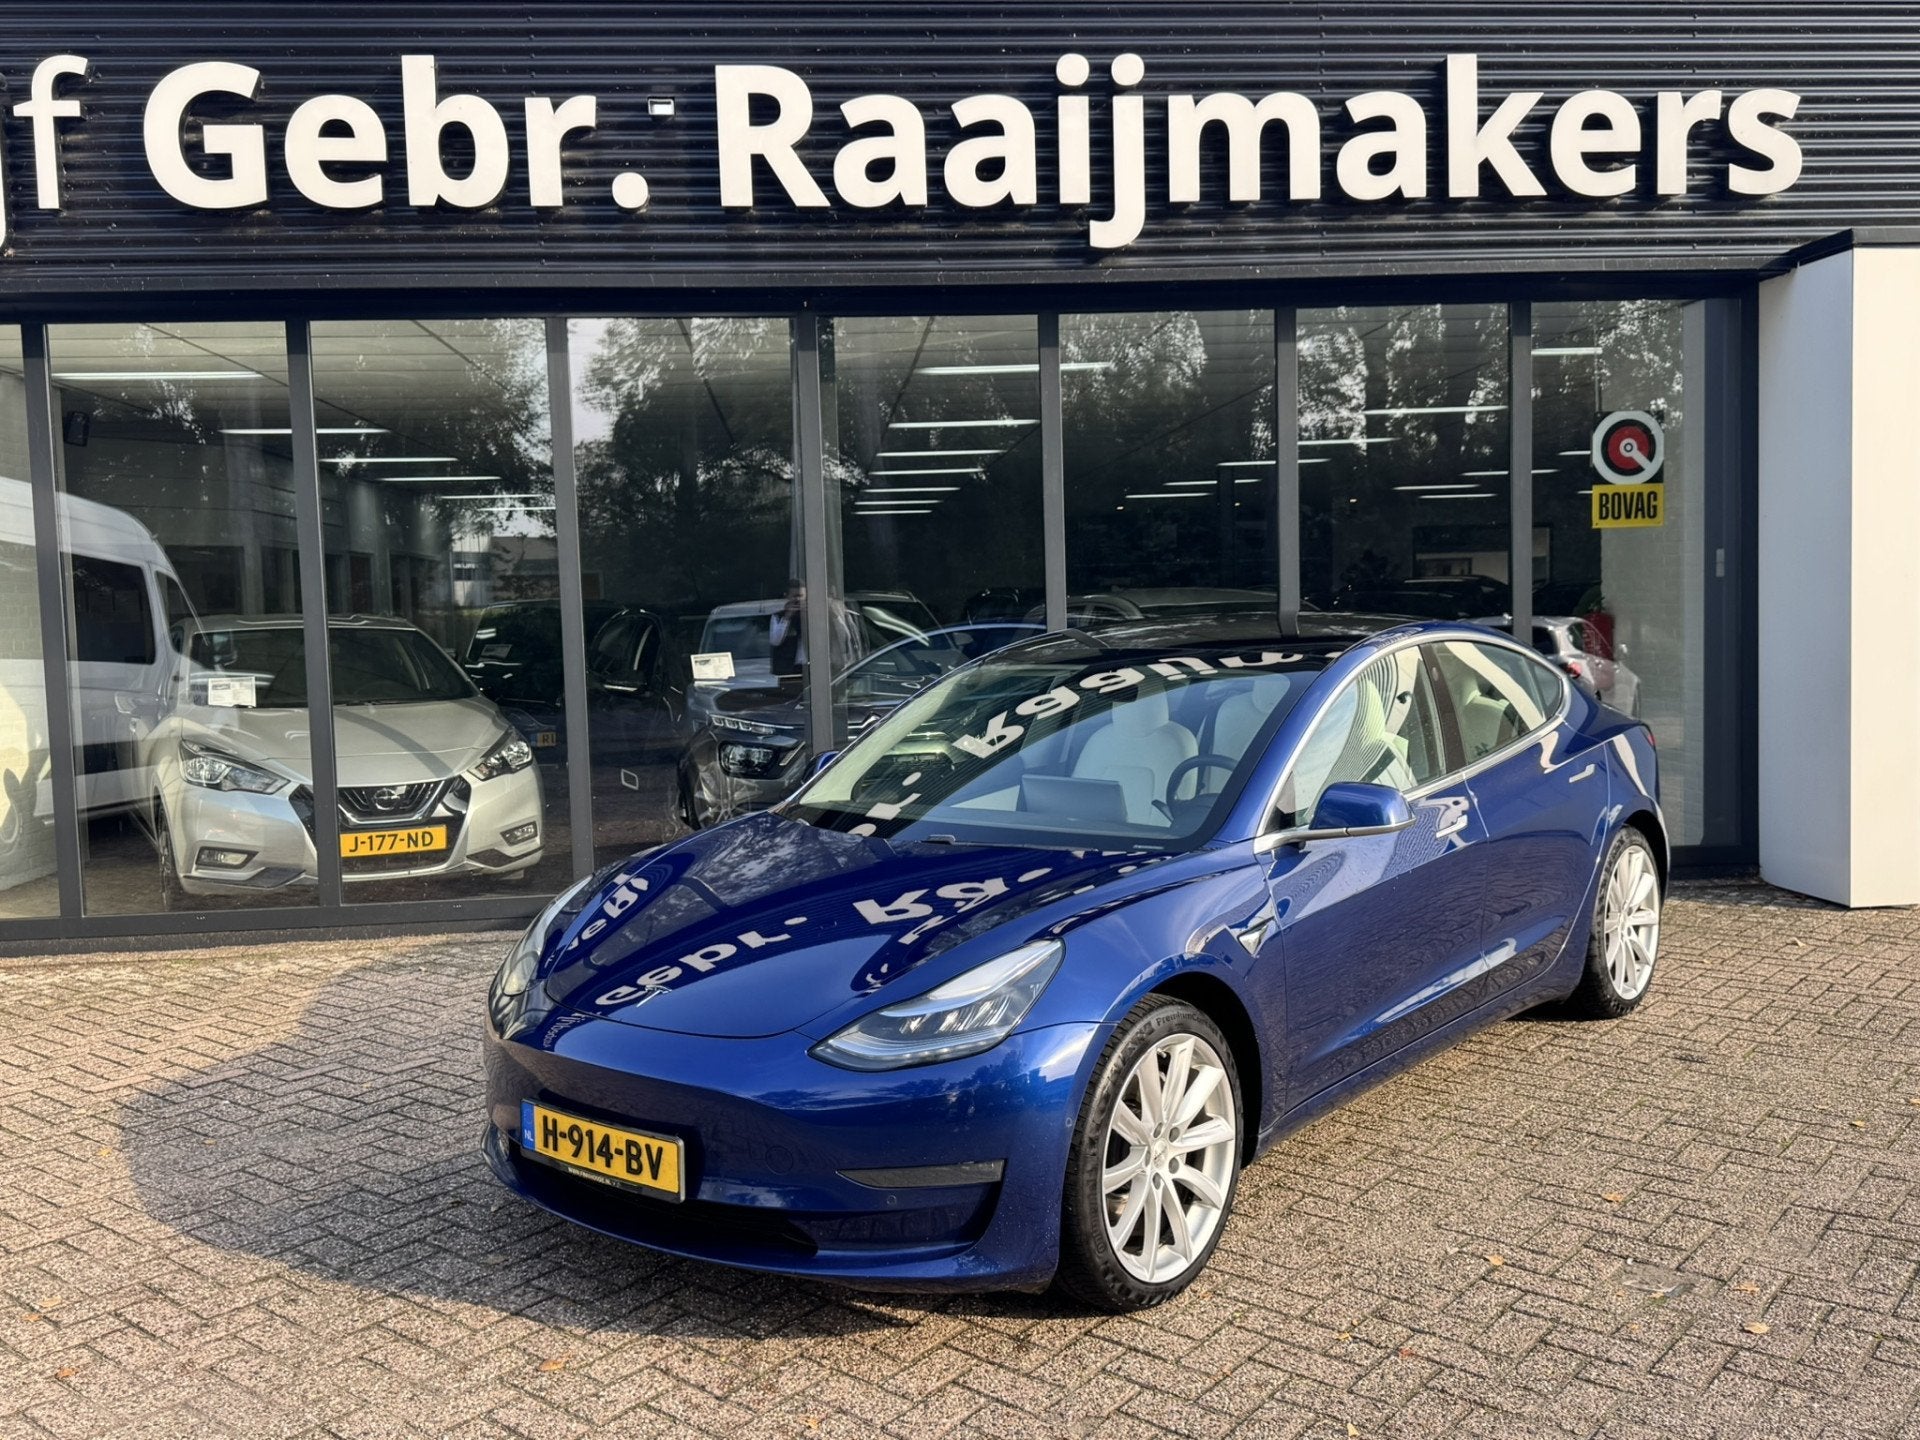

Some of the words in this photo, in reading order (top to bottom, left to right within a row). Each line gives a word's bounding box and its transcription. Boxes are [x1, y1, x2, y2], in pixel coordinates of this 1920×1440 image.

[0, 55, 88, 258] f
[142, 54, 649, 209] Gebr.
[714, 53, 1804, 249] Raaijmakers
[1598, 490, 1658, 521] BOVAG
[349, 830, 434, 853] J-177-ND
[524, 1129, 534, 1142] NL
[542, 1114, 664, 1181] H-914-BV
